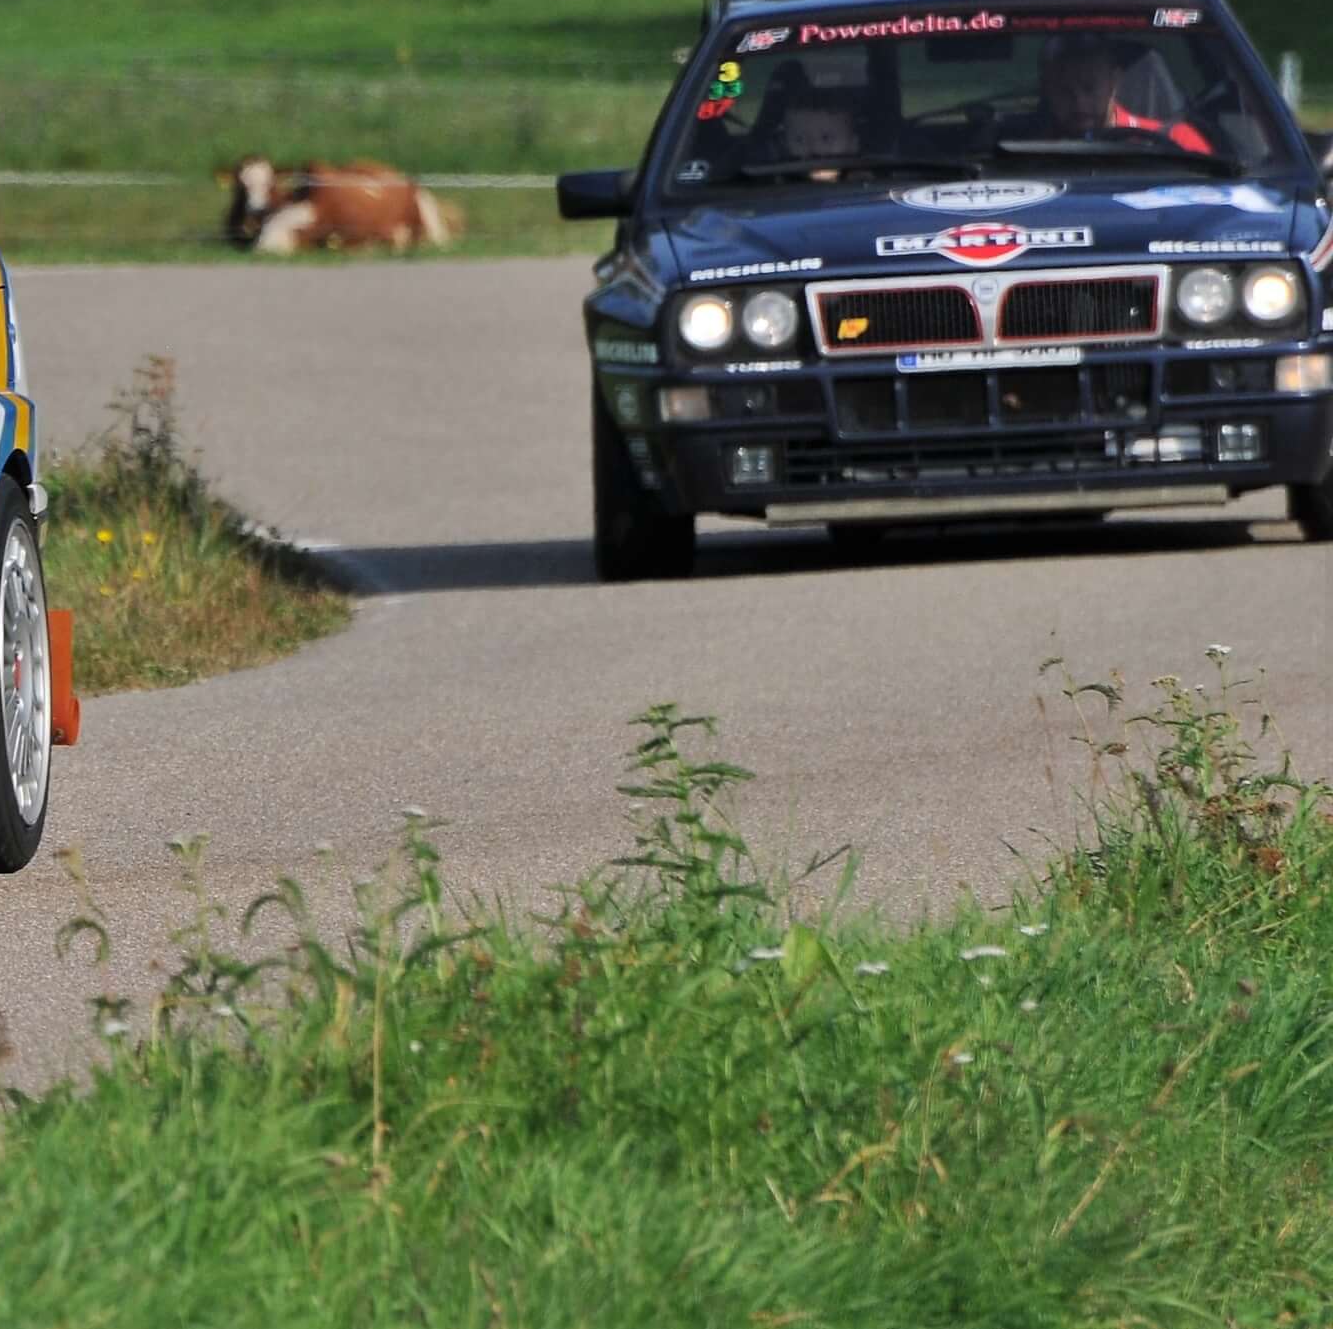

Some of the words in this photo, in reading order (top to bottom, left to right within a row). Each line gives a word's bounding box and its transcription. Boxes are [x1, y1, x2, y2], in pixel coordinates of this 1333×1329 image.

[798, 11, 1006, 43] Powerdelta.de
[718, 61, 740, 82] 3
[893, 231, 1077, 250] MARTINI
[1148, 240, 1283, 253] MICHELIN
[690, 257, 823, 281] MICHELIN
